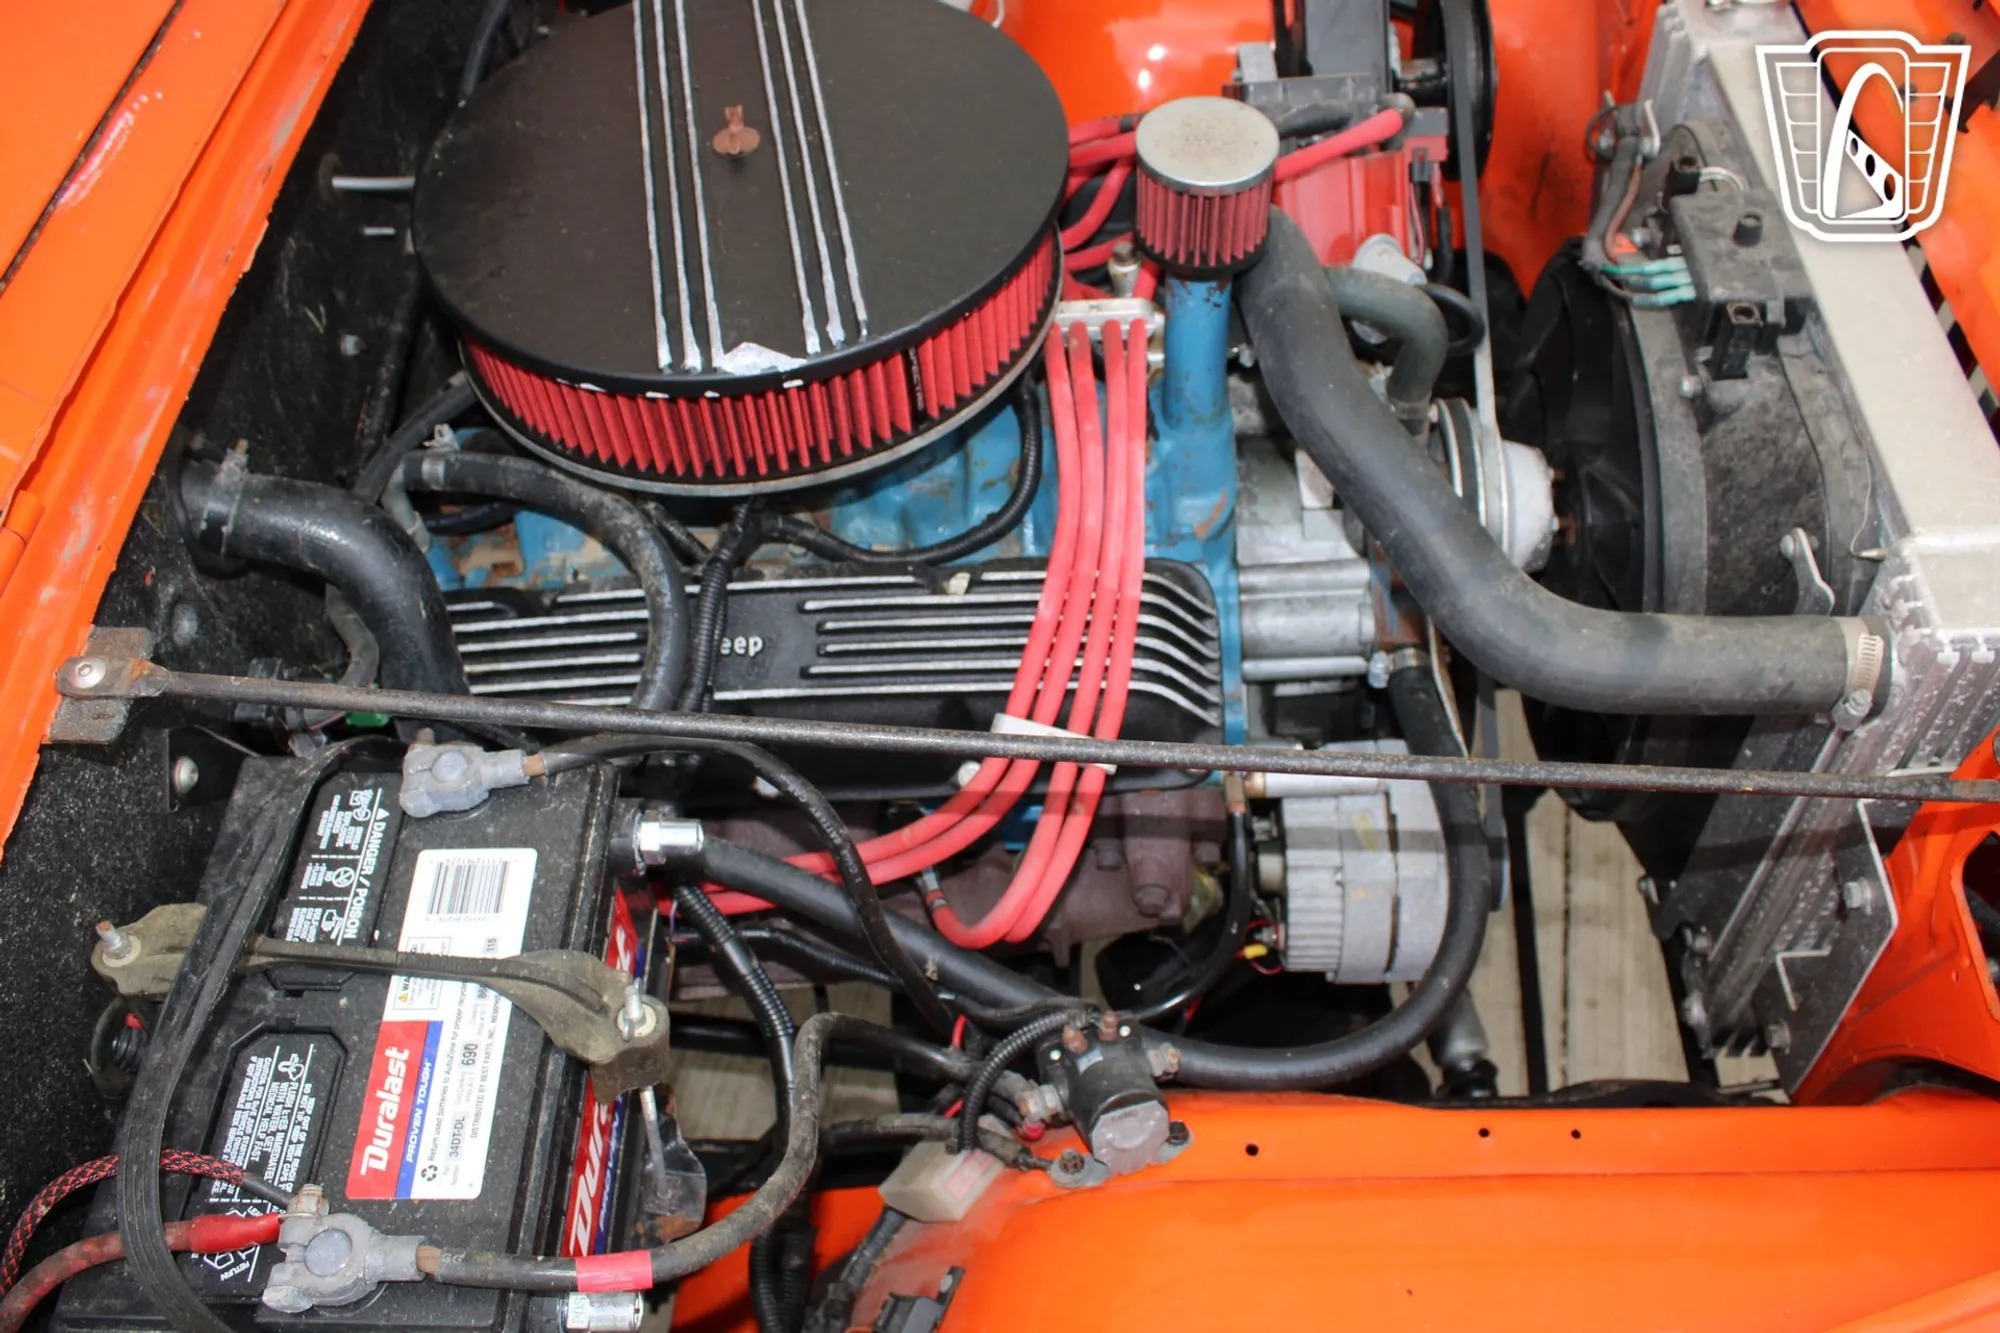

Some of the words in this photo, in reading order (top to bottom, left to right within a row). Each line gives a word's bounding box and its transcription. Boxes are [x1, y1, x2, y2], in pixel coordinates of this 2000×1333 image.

[720, 636, 763, 657] eep
[362, 821, 385, 875] DANGER
[344, 887, 368, 938] POISON
[486, 938, 497, 952] 115
[454, 1008, 463, 1030] proper
[444, 1041, 456, 1075] AutoZone
[461, 1043, 478, 1066] 690
[263, 1081, 279, 1115] MEDICAL
[276, 1082, 289, 1102] WITH
[284, 1082, 299, 1108] FLUSH
[437, 1084, 449, 1116] batteries
[470, 1094, 484, 1139] DISTRIBUTED
[480, 1065, 489, 1083] BEST
[360, 1046, 410, 1175] Duralast
[257, 1118, 270, 1139] HELP
[406, 1107, 423, 1162] PROVEN
[435, 1117, 443, 1135] used
[449, 1116, 465, 1157] 34DT-DL
[250, 1141, 263, 1161] FAST
[263, 1136, 275, 1152] GET
[264, 1131, 285, 1182] IMMEDIATEL
[427, 1137, 438, 1162] Return
[220, 1261, 249, 1281] RETURN
